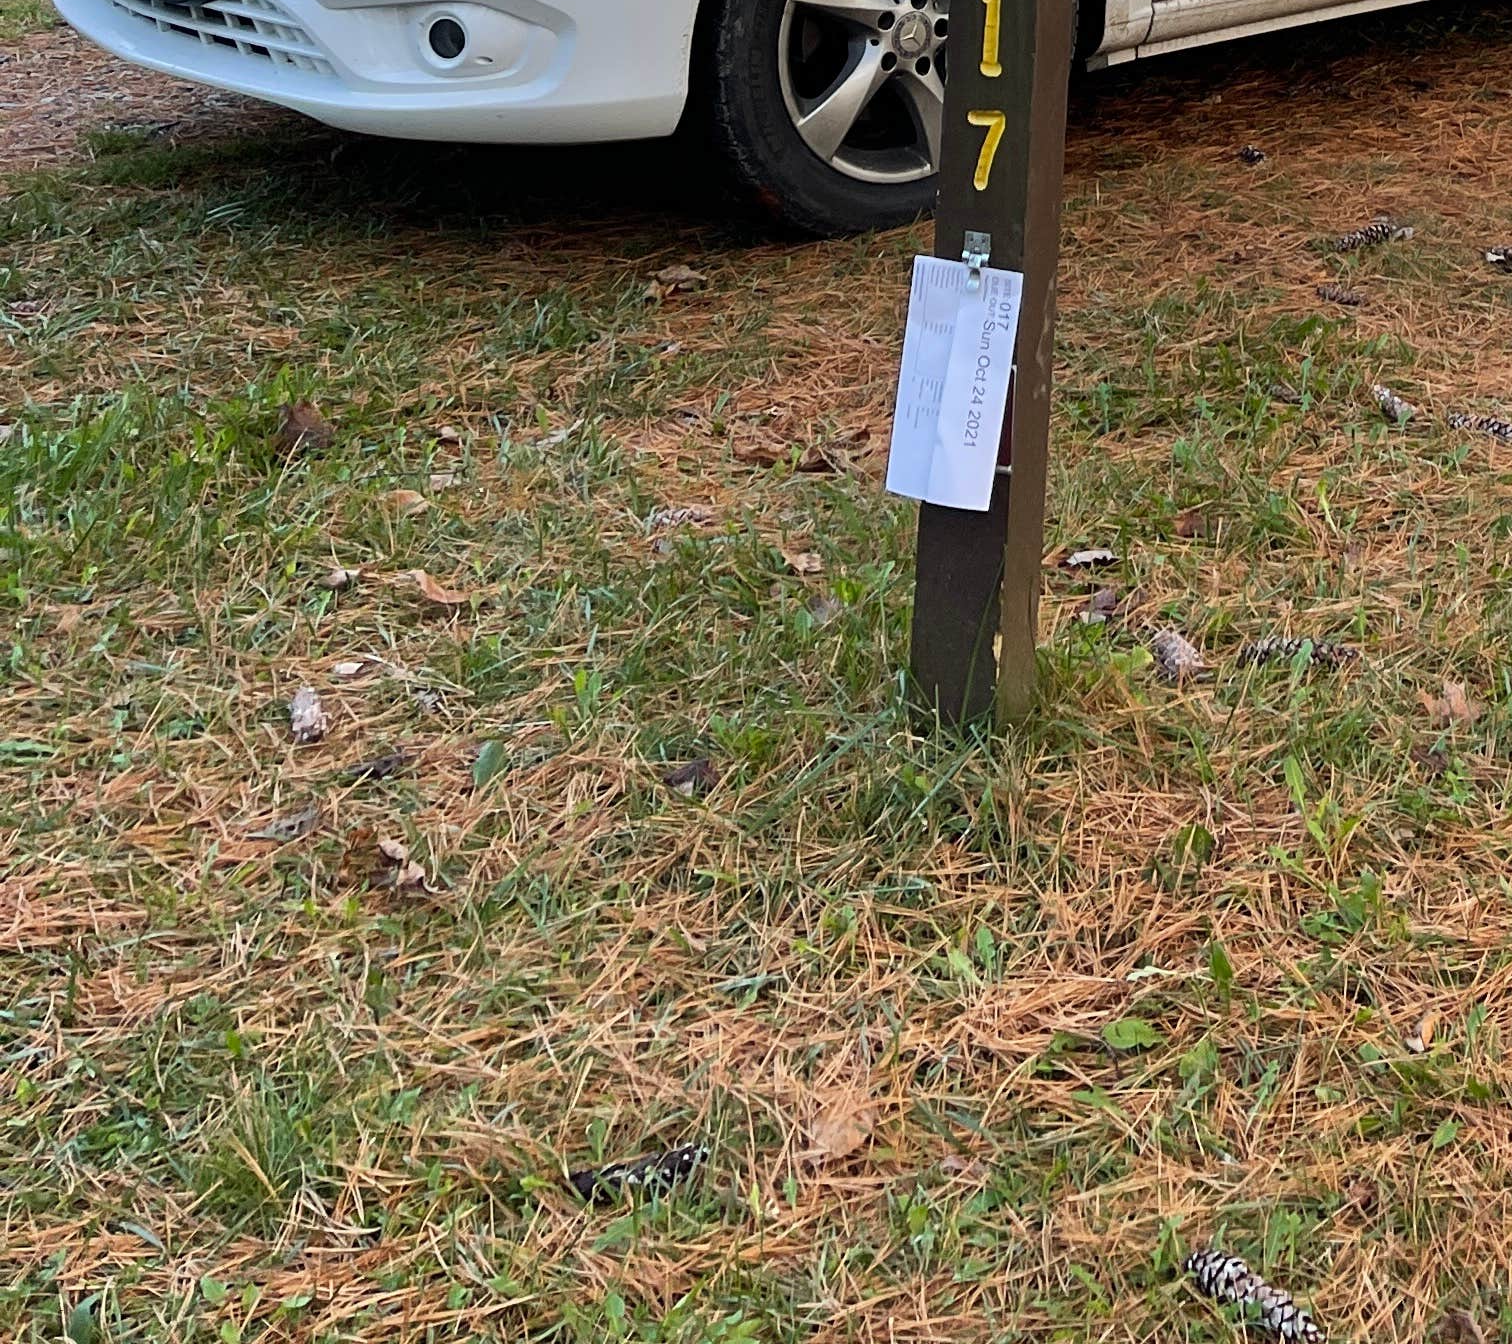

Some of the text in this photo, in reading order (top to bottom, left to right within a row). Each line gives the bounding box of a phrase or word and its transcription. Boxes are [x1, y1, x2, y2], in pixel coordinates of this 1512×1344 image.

[997, 301, 1012, 331] 017
[979, 319, 996, 350] Sun
[975, 354, 991, 382] Oct
[970, 386, 985, 406] 24
[963, 409, 981, 448] 2021
